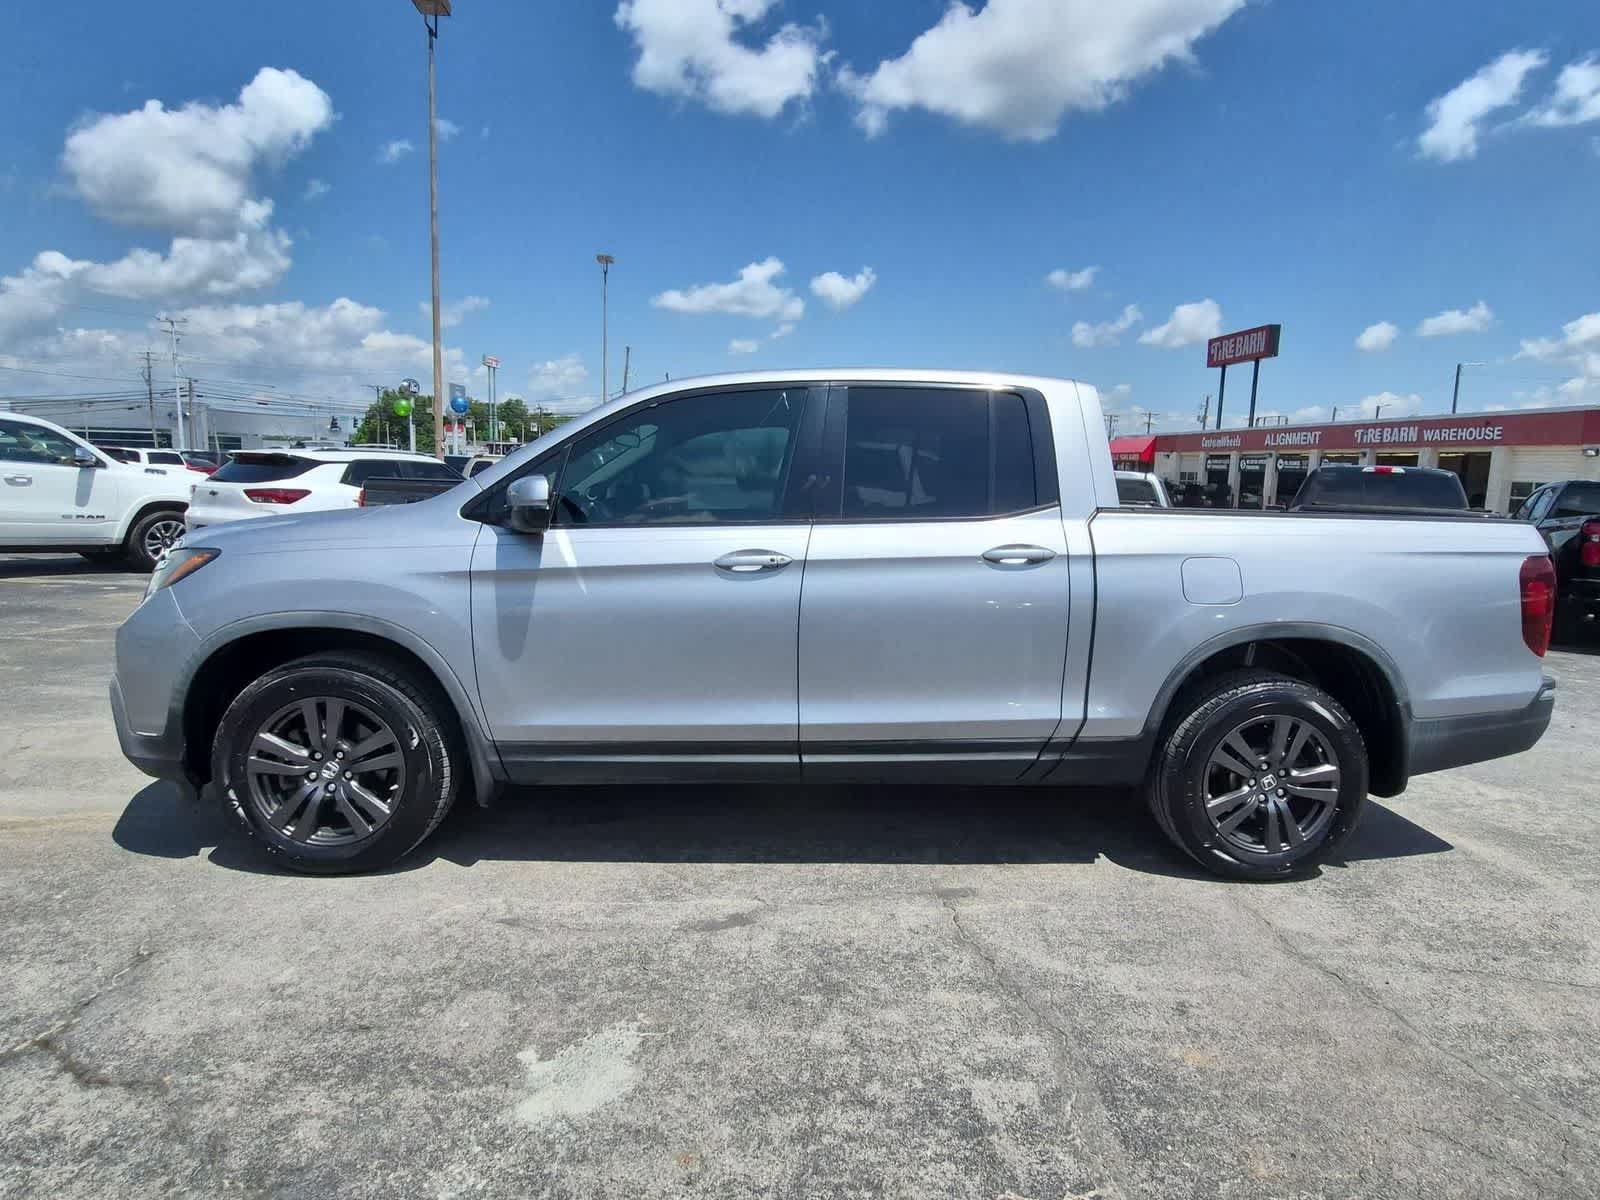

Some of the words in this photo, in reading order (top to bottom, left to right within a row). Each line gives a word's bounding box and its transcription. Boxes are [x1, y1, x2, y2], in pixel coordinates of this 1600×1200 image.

[1236, 331, 1266, 357] BARN
[1264, 431, 1321, 446] ALIGNMENT
[1383, 426, 1418, 443] BARN
[1423, 426, 1503, 441] WAREHOUSE
